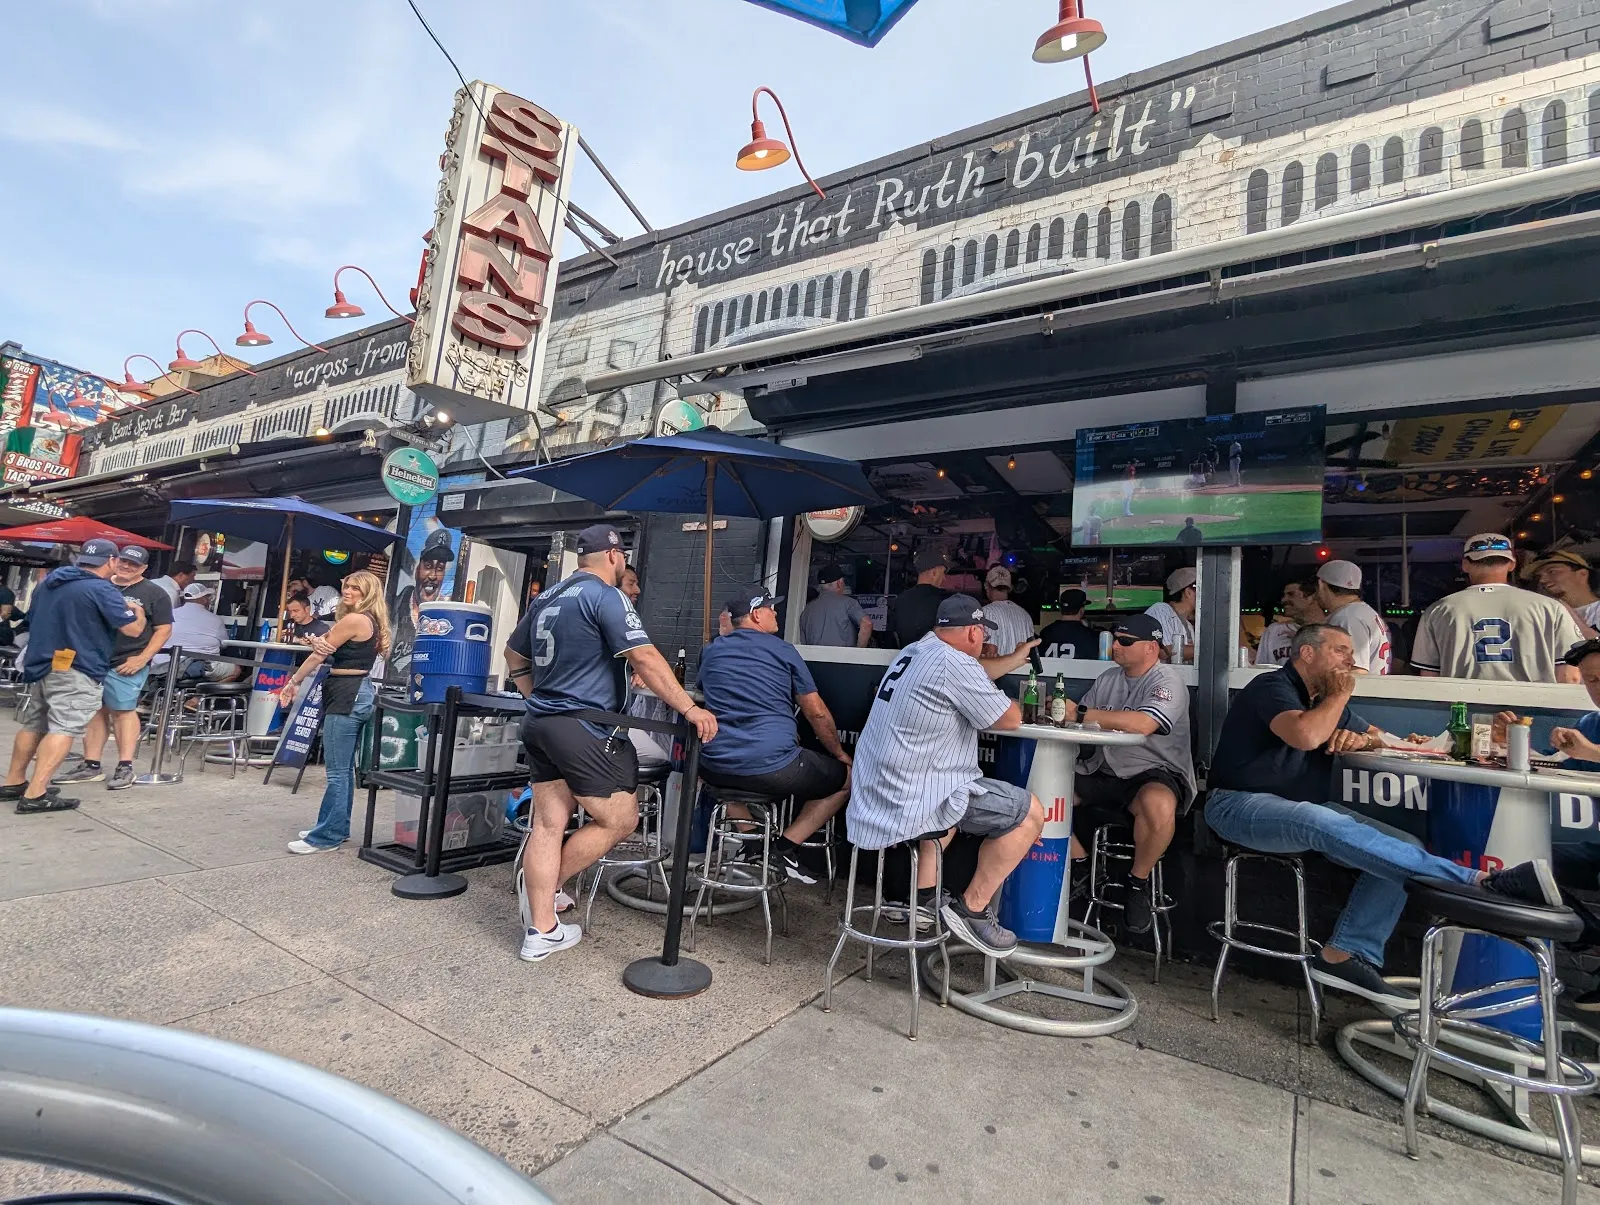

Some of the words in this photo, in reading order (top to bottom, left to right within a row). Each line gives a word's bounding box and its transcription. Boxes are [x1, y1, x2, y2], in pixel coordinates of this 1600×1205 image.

[655, 244, 754, 288] house
[767, 194, 855, 256] that
[865, 151, 985, 230] Ruth
[5, 360, 12, 369] 3
[13, 362, 35, 375] BROS
[355, 337, 408, 377] from
[134, 408, 164, 437] Sports
[166, 404, 188, 426] Bar
[5, 468, 37, 482] TACOS
[6, 453, 15, 464] 3
[16, 455, 42, 471] BROS
[43, 462, 71, 478] PIZZA
[390, 466, 434, 488] Heineken
[868, 612, 884, 621] TAFF
[534, 605, 562, 667] 5
[1472, 617, 1514, 664] 2
[877, 656, 912, 703] 2
[295, 715, 307, 726] WAIT
[305, 717, 313, 727] TO
[311, 719, 319, 729] BE
[302, 706, 319, 718] PLEASE
[294, 725, 312, 738] SEATED
[1044, 797, 1065, 822] ull
[1026, 852, 1060, 862] RINK
